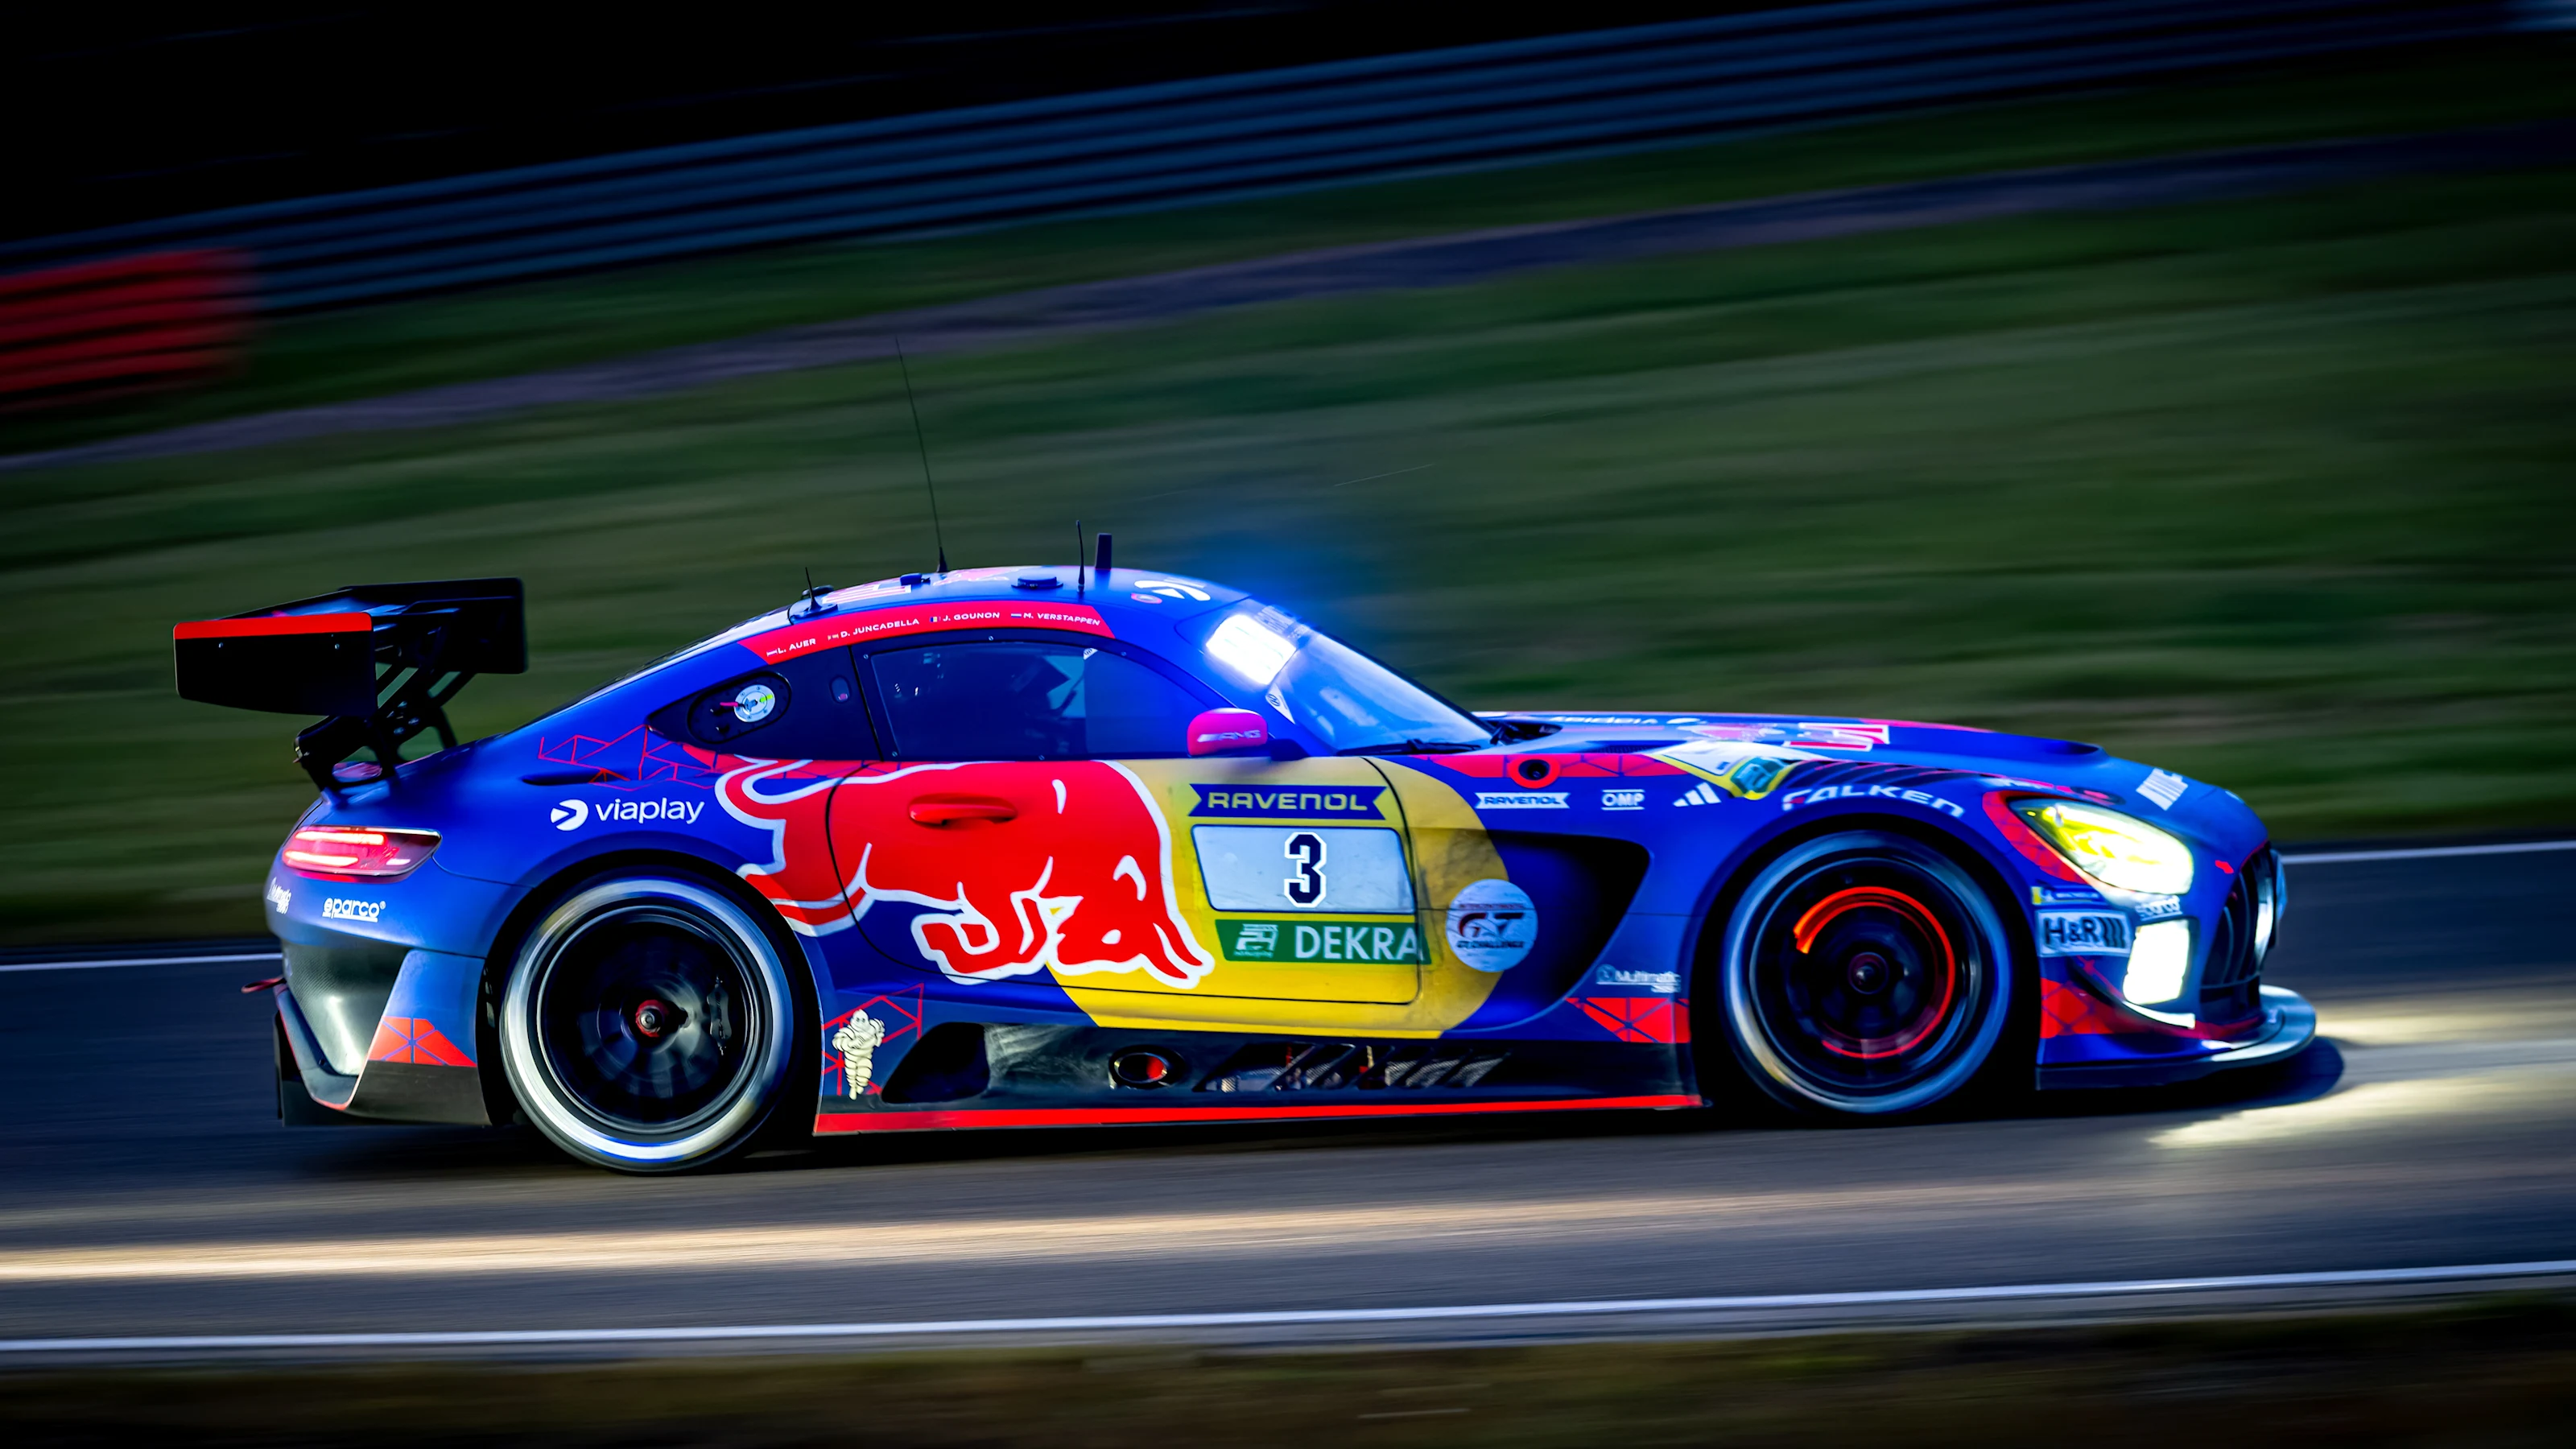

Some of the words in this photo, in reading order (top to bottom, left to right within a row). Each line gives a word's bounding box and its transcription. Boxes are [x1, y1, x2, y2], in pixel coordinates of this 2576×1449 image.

[788, 638, 817, 651] AUER
[840, 630, 851, 638] D.
[852, 617, 920, 636] JUNCADELLA
[953, 612, 1001, 621] GOUNON
[1037, 613, 1101, 626] VERSTAPPEN
[595, 797, 705, 824] viaplay
[1208, 791, 1368, 811] RAVENOL
[1484, 795, 1562, 805] RAVENOL
[1601, 792, 1645, 807] OMP
[1781, 785, 1966, 818] FALKEN
[1284, 832, 1327, 908] 3
[1295, 926, 1425, 961] DEKRA
[2043, 916, 2101, 945] H&R
